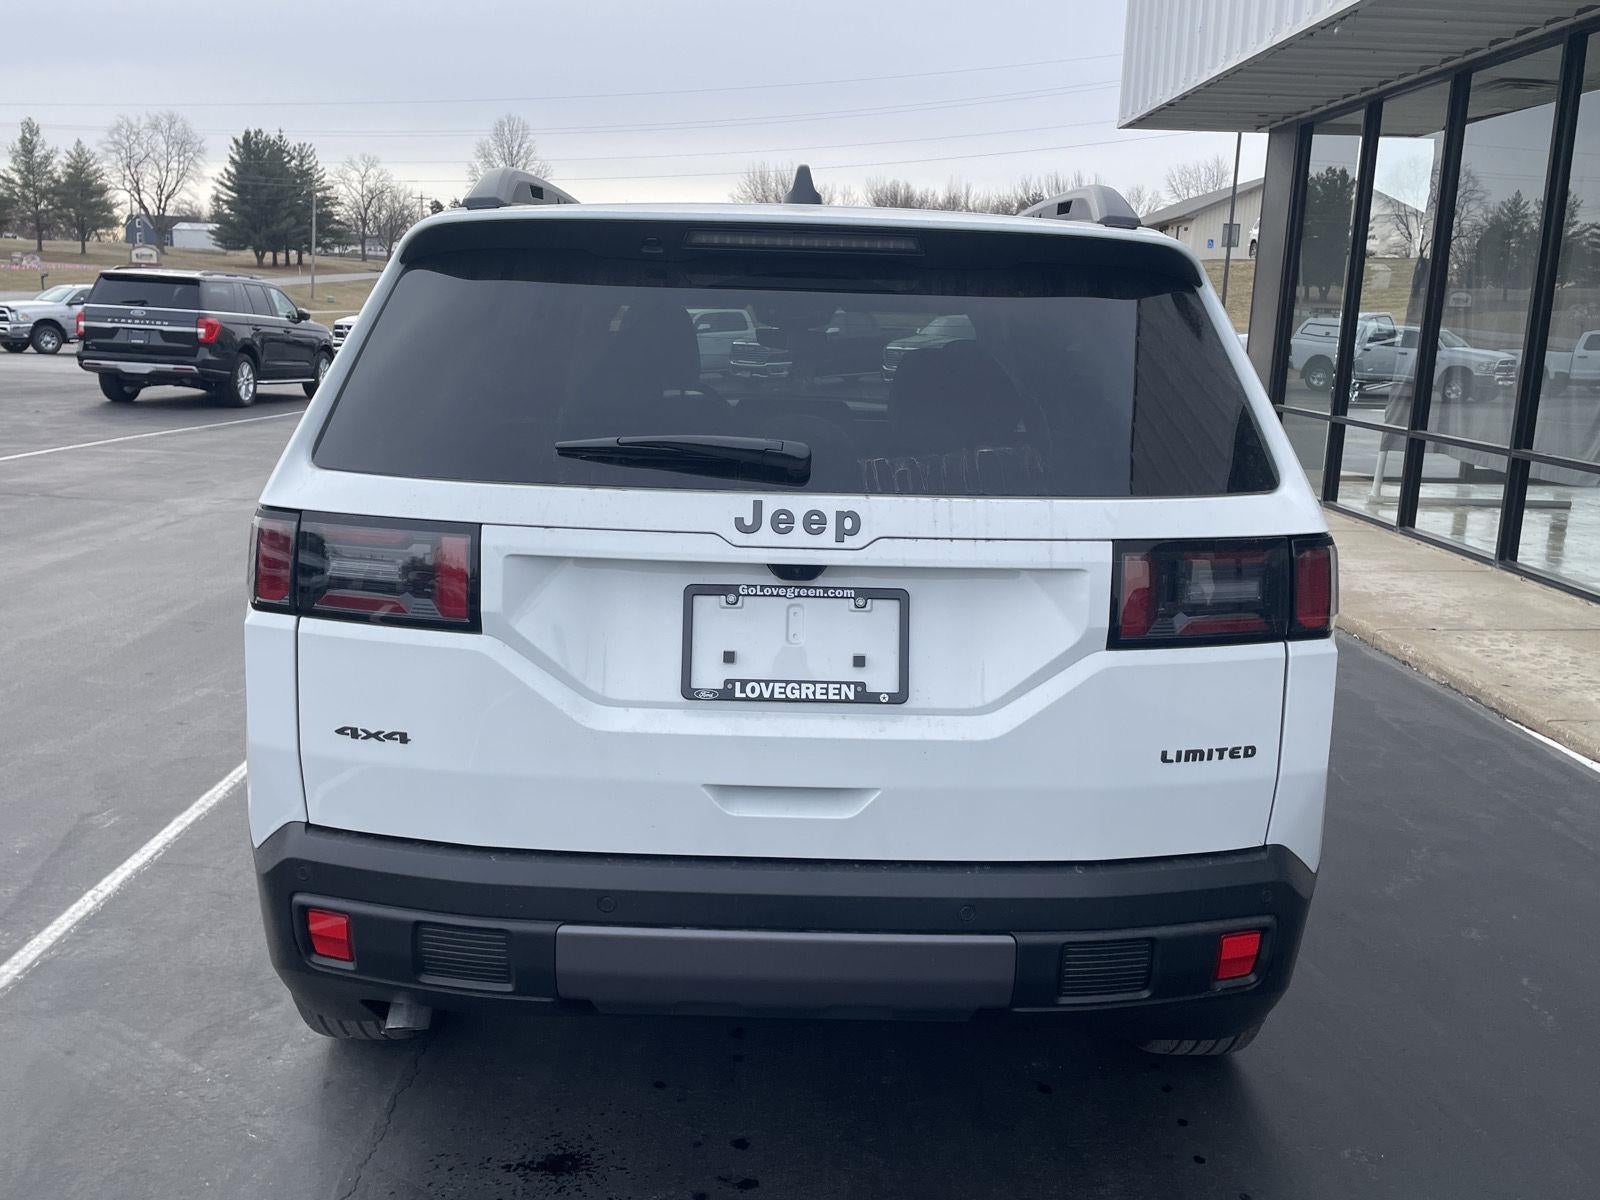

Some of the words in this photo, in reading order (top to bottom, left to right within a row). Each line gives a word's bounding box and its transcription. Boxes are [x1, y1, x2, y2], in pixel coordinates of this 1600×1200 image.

[734, 499, 862, 543] Jeep
[738, 584, 855, 598] GoLovegreen.com
[697, 690, 717, 699] Ford
[734, 681, 855, 700] LOVEGREEN
[1160, 745, 1257, 763] LIMITED
